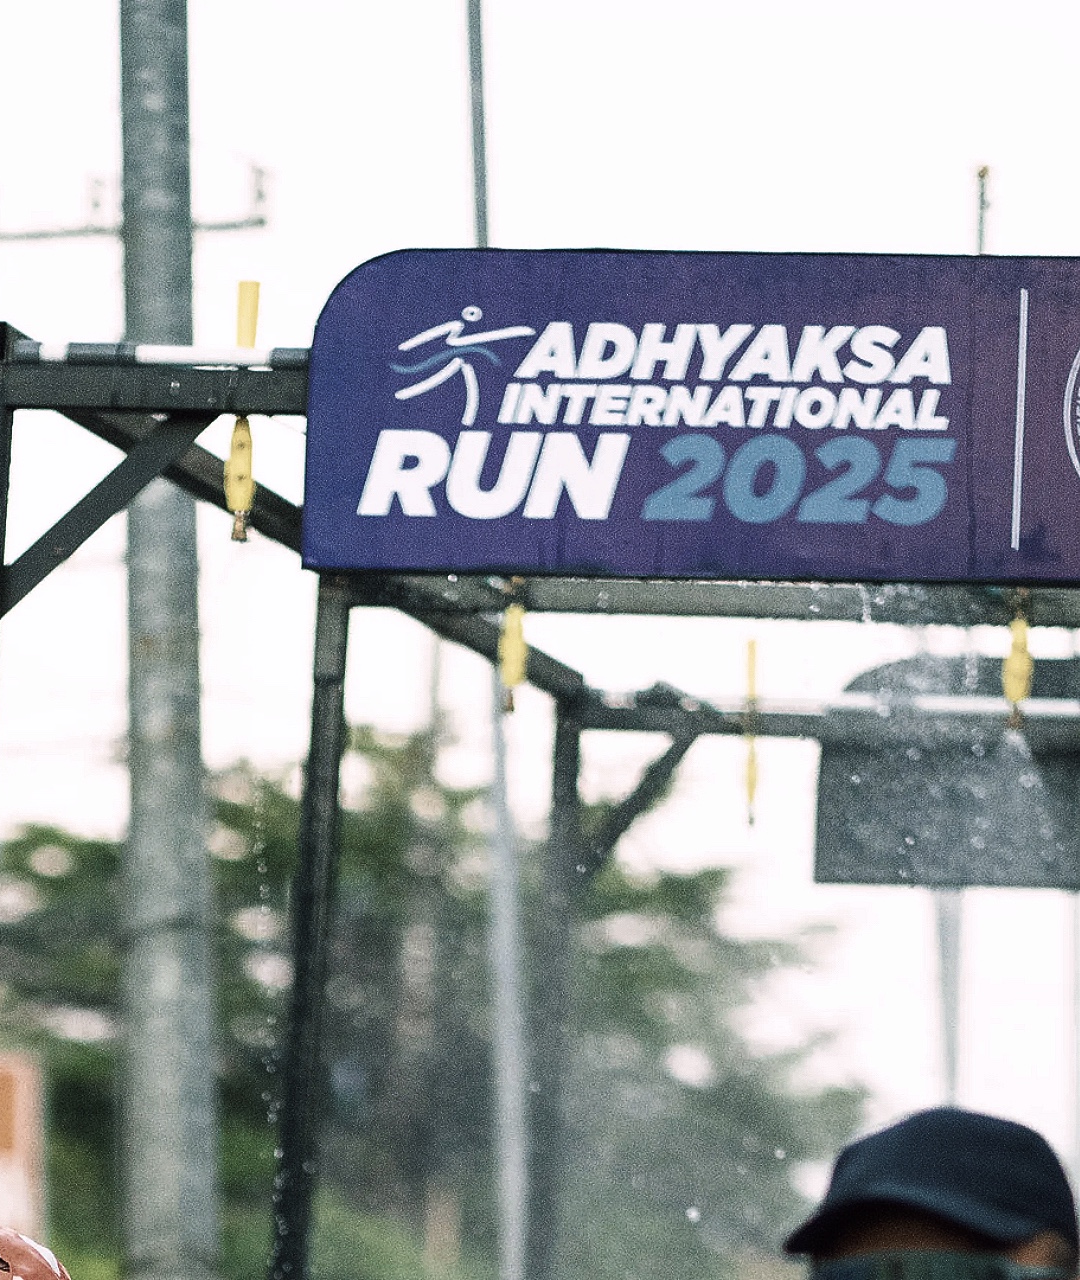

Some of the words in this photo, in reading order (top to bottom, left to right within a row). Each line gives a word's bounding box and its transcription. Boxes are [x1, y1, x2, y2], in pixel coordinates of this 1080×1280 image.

[513, 322, 952, 384] ADHYAKSA
[497, 383, 950, 430] INTERNATIONAL
[356, 429, 631, 520] RUN
[641, 433, 958, 526] 2025
